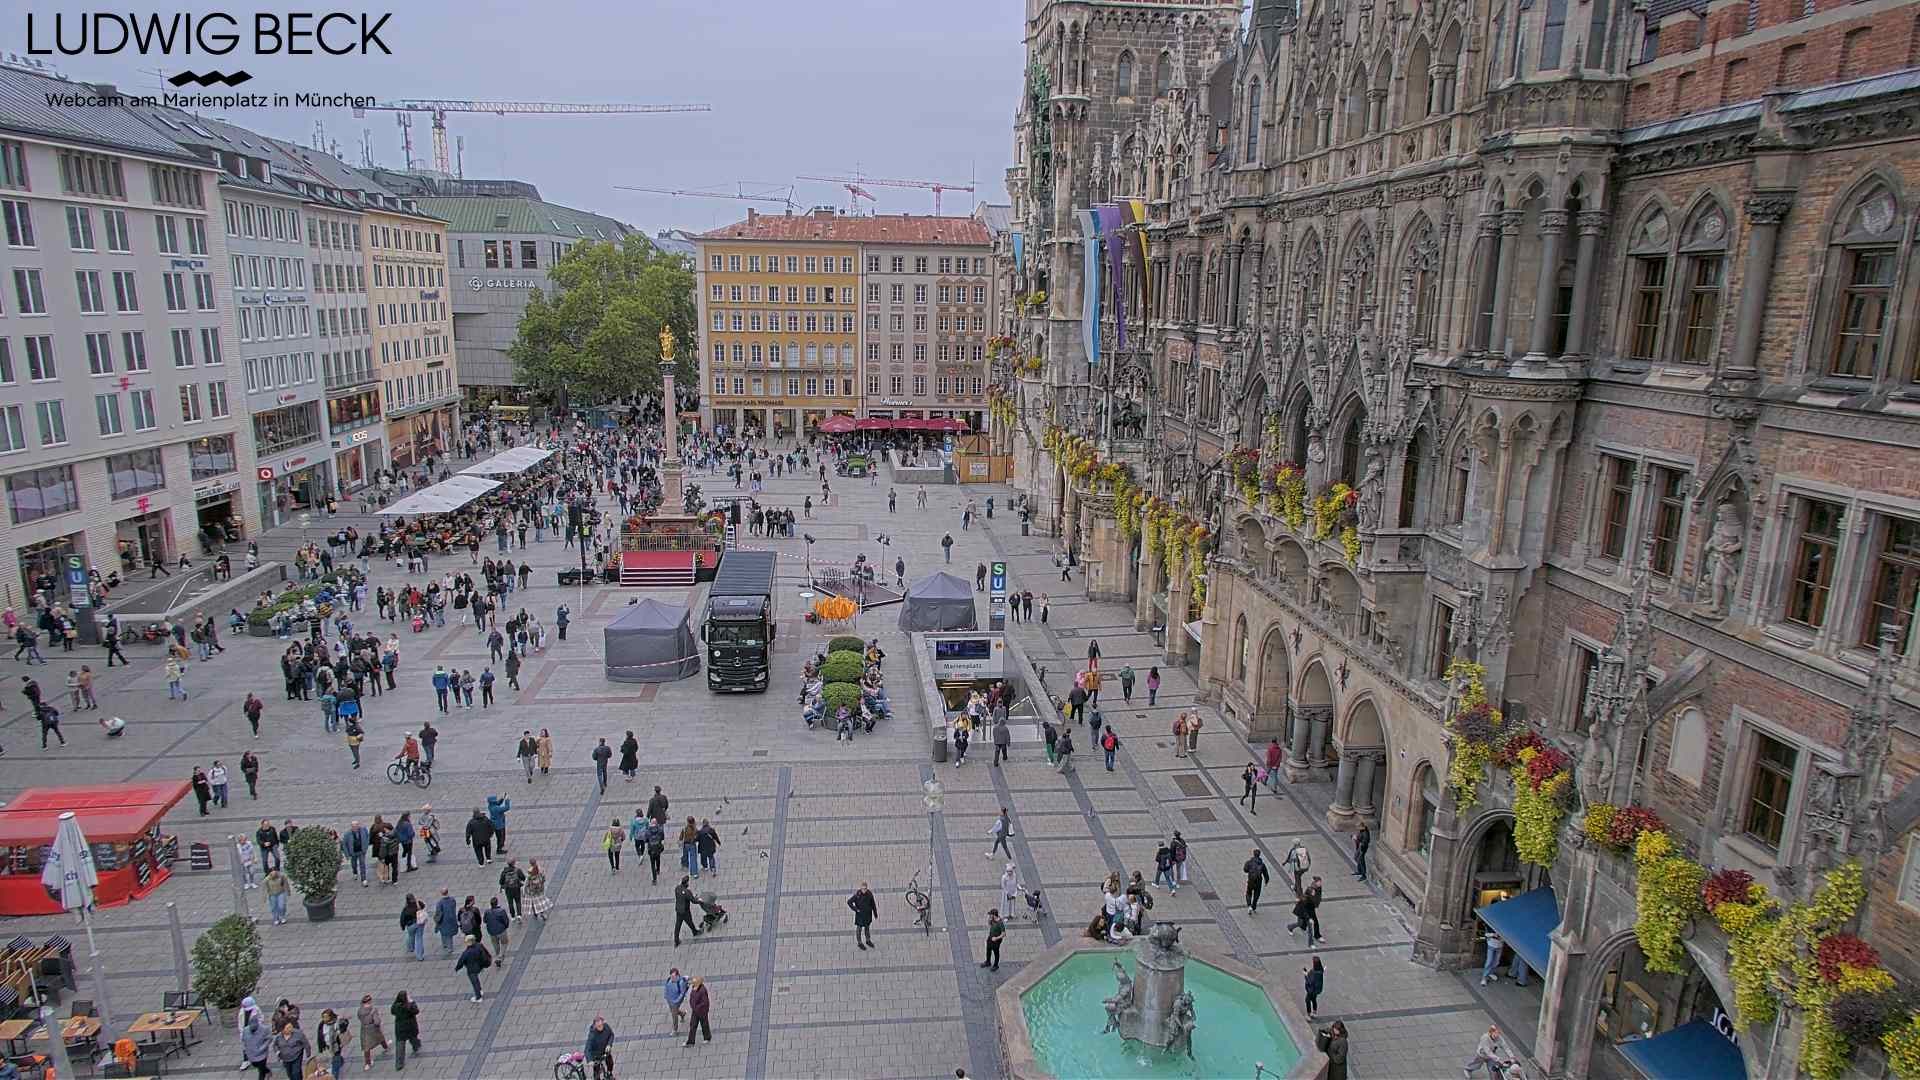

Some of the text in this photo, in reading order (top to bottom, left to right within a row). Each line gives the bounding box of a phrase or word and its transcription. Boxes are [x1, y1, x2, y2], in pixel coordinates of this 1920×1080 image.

[486, 279, 536, 288] GALERIA
[69, 556, 81, 569] S
[993, 563, 1004, 575] S
[71, 570, 83, 584] U
[994, 576, 1003, 589] U
